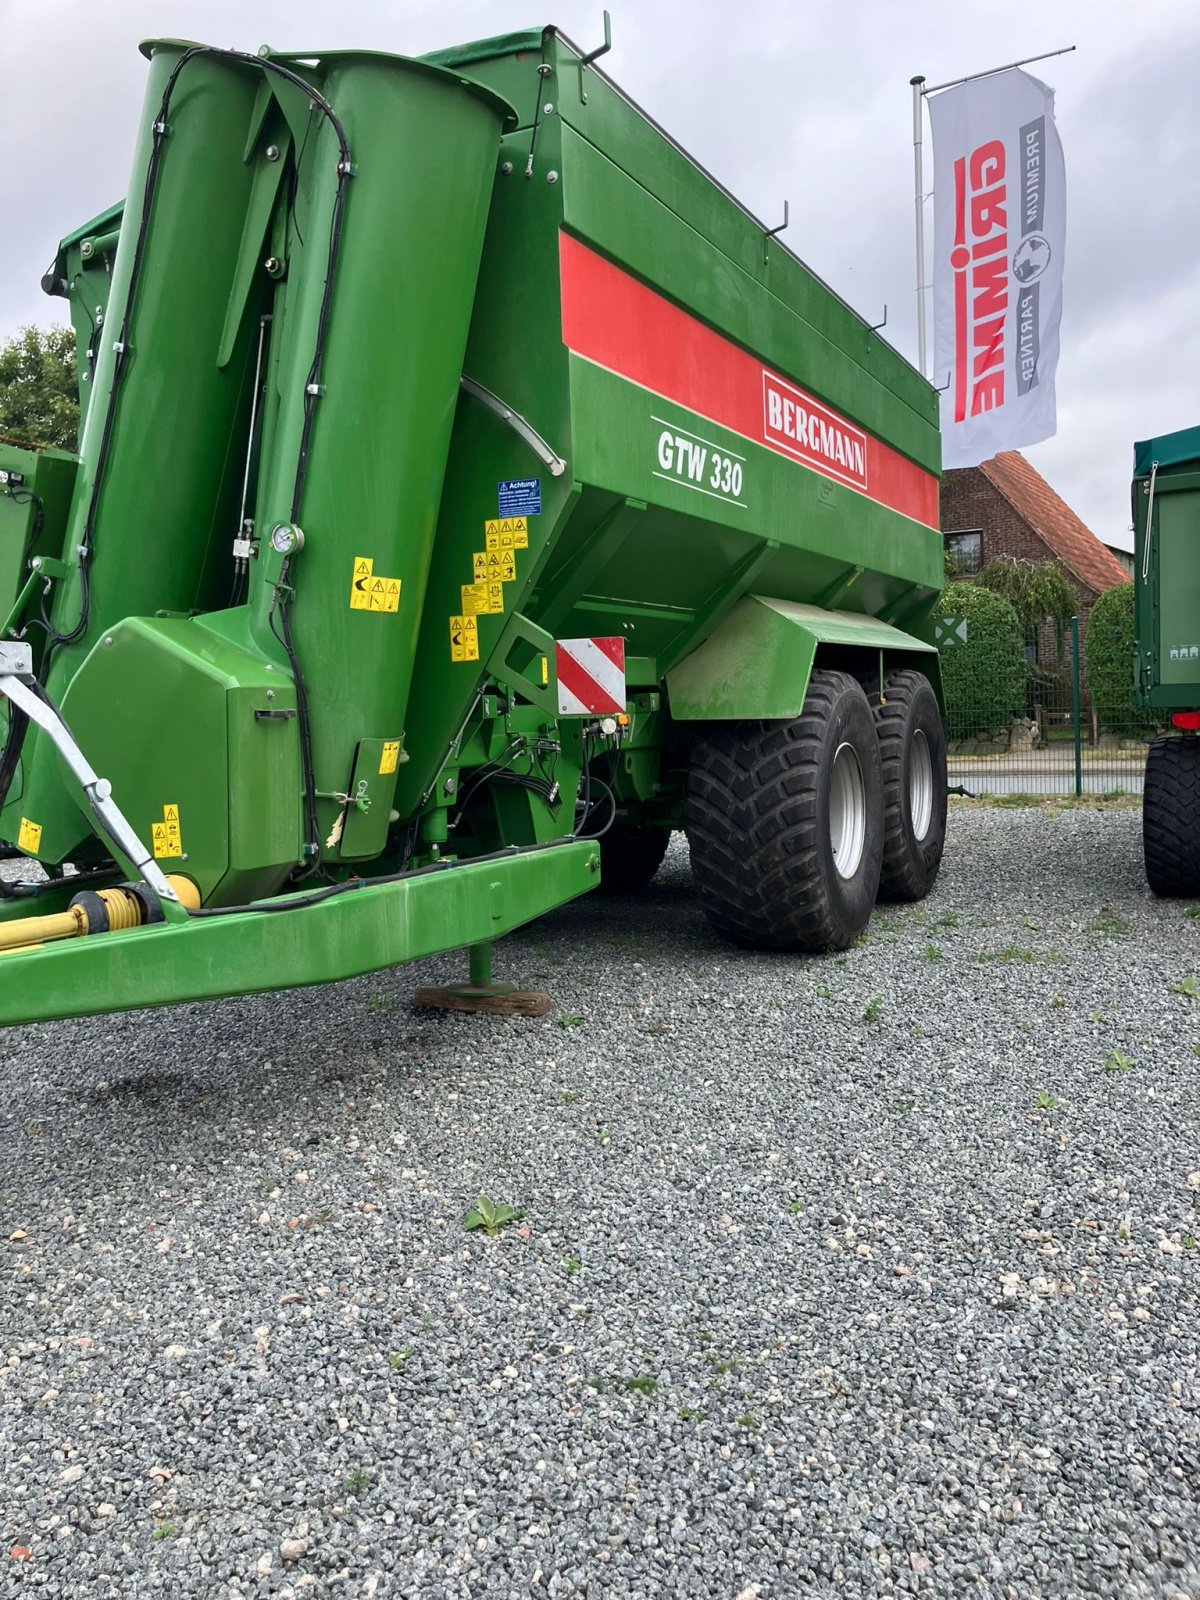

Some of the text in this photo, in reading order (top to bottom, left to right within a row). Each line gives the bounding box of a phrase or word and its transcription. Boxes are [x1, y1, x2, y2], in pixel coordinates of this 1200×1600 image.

[657, 431, 743, 497] GTW 330
[768, 388, 865, 477] BERGMANN
[509, 479, 537, 489] Achtung!
